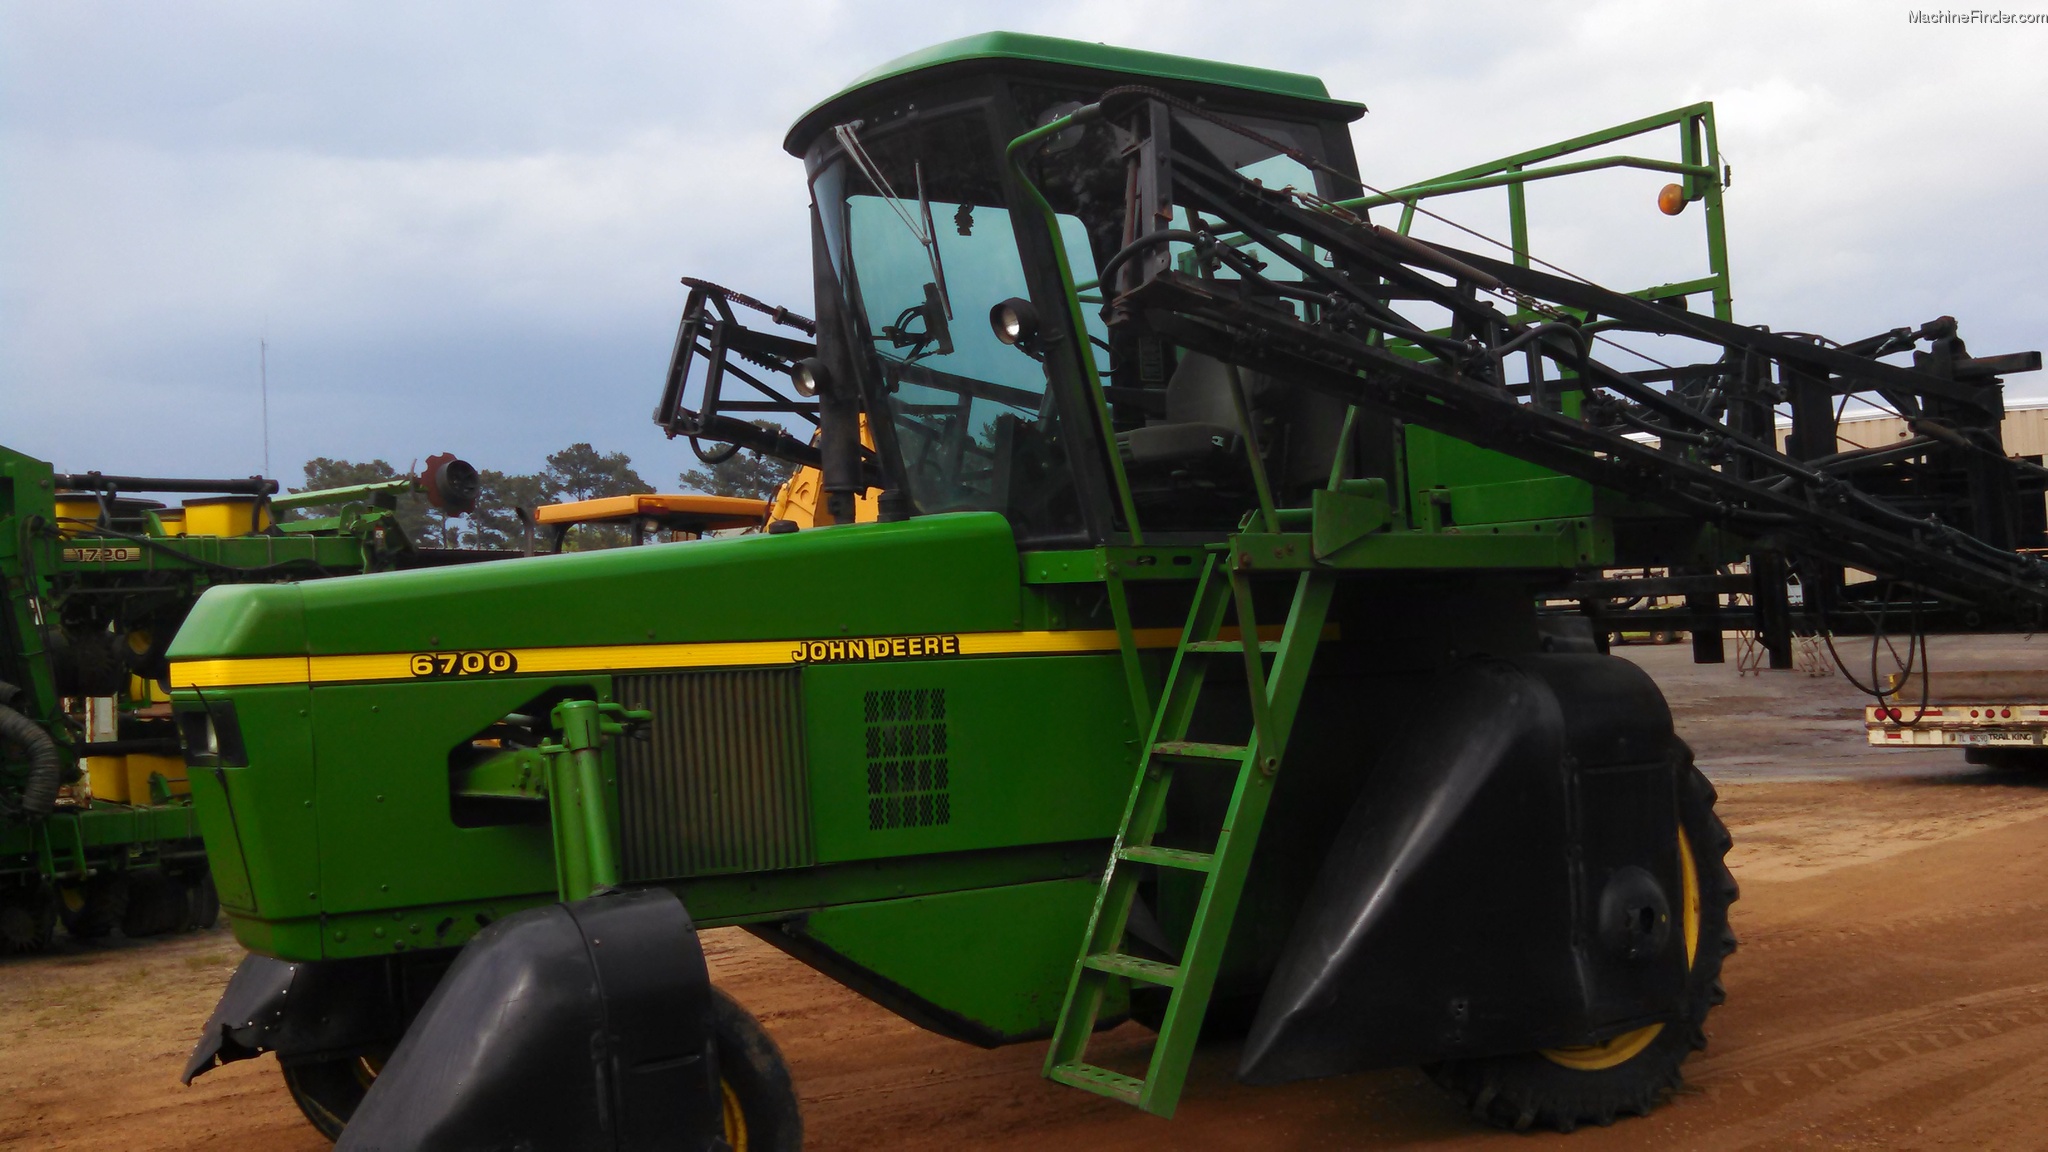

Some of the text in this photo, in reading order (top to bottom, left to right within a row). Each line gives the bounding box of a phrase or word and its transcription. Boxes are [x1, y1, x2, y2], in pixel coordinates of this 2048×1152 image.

[77, 548, 128, 561] 1720
[791, 635, 958, 661] JOHN DEERE
[411, 651, 515, 676] 6700
[1988, 733, 2010, 741] TRAIL
[2011, 733, 2032, 741] KING
